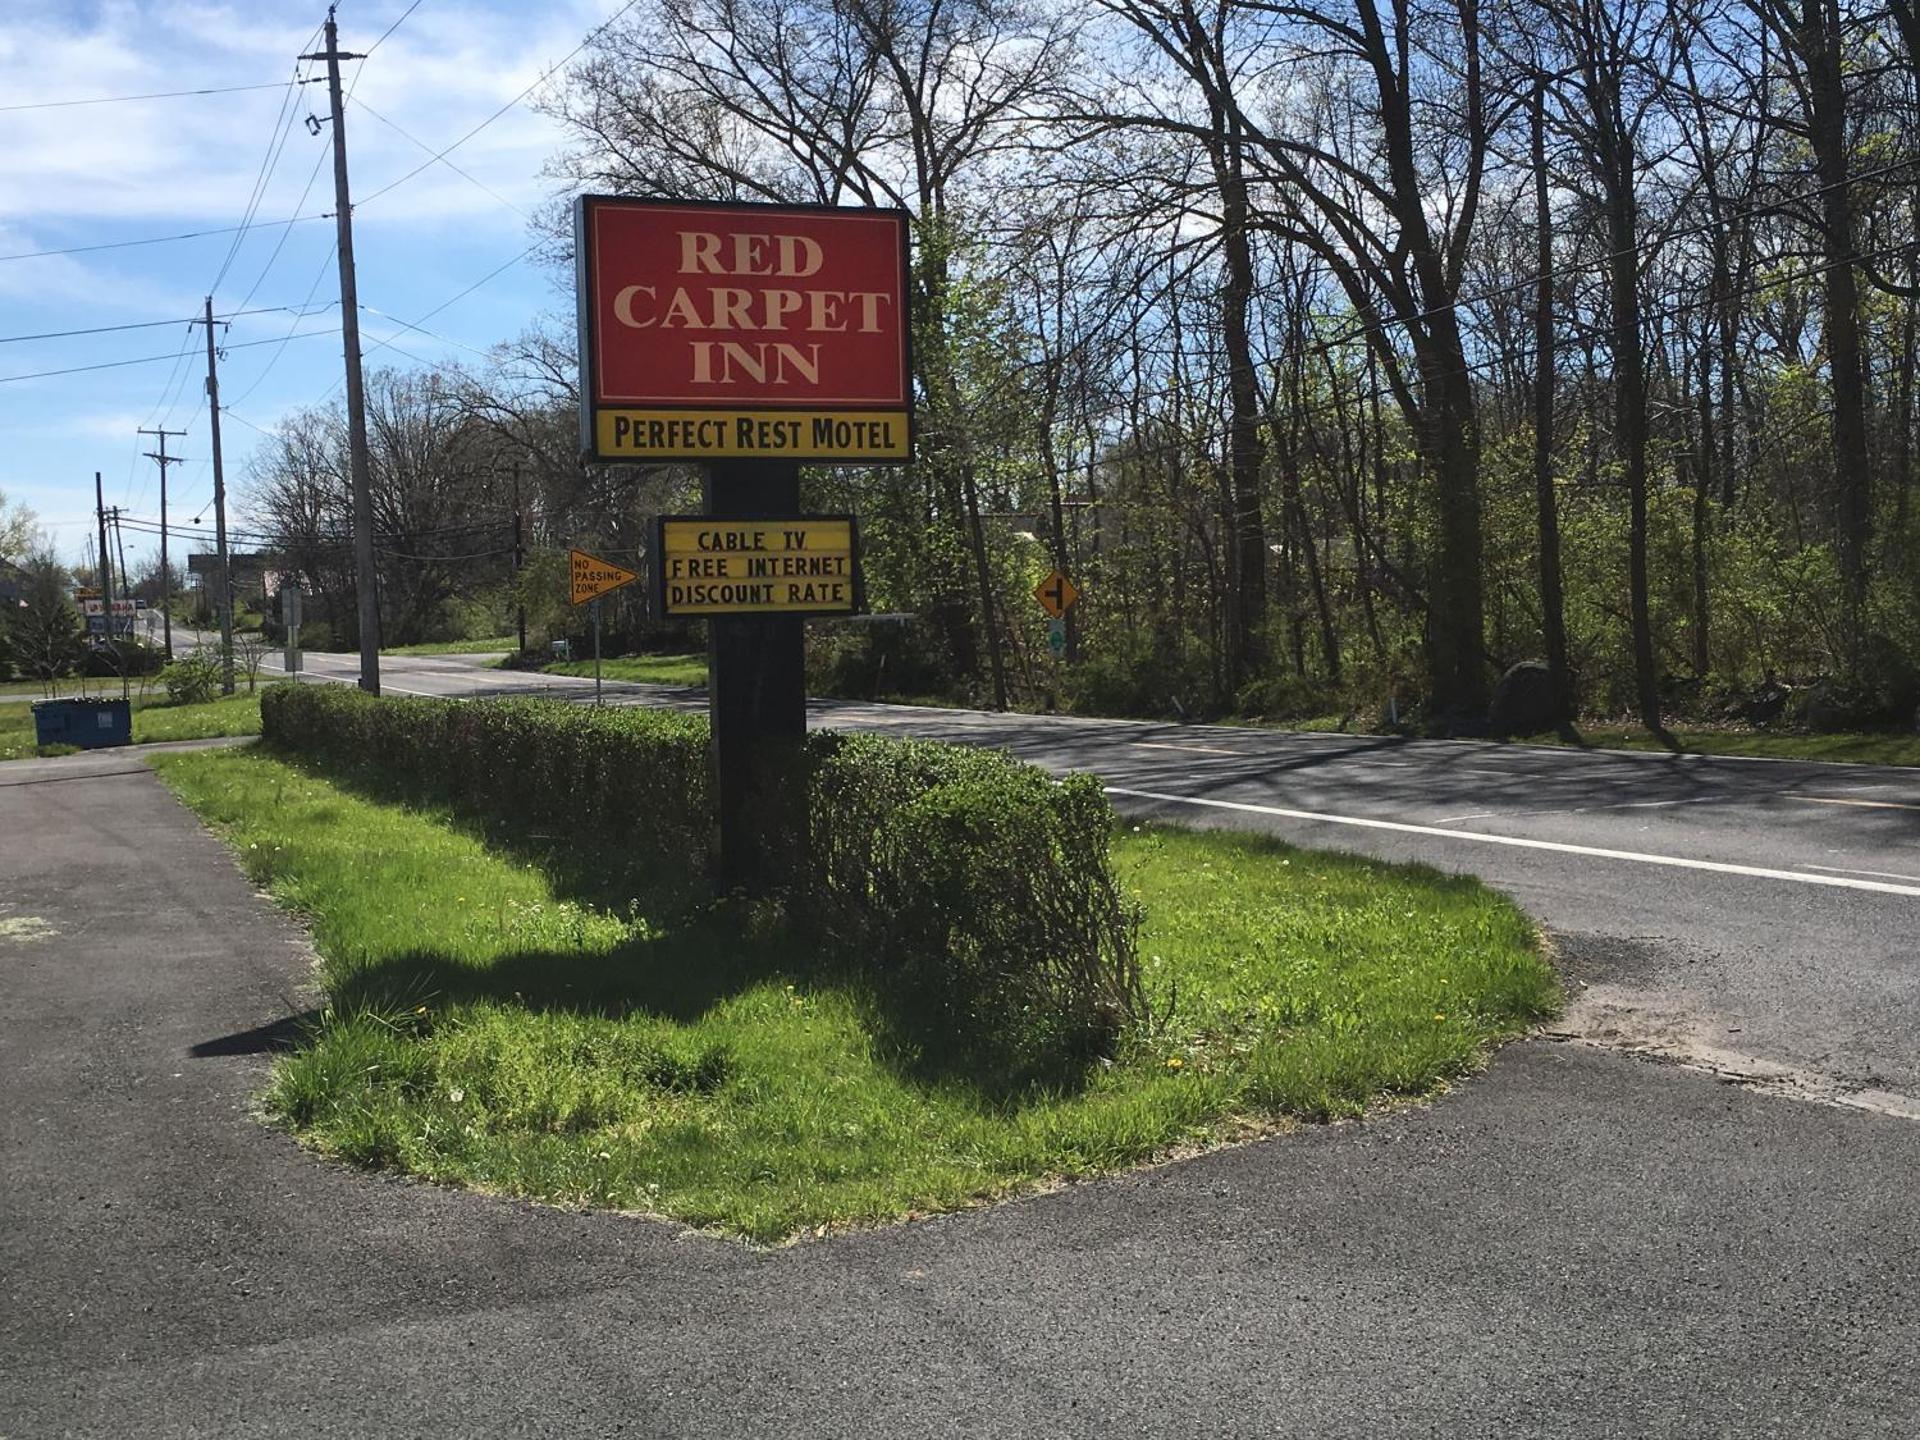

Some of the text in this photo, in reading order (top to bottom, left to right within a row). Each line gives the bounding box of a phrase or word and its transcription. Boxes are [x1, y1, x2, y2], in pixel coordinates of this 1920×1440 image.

[676, 231, 824, 278] RED
[613, 284, 891, 333] CARPET
[689, 341, 823, 385] INN
[614, 415, 895, 449] PERFECT REST MOTEL
[698, 531, 806, 551] CABLE TV
[574, 560, 589, 570] NO
[672, 557, 844, 578] FREE INTERNET
[575, 571, 622, 582] PASSING
[575, 583, 599, 594] ZONE
[672, 583, 843, 604] DISCOUNT RATE
